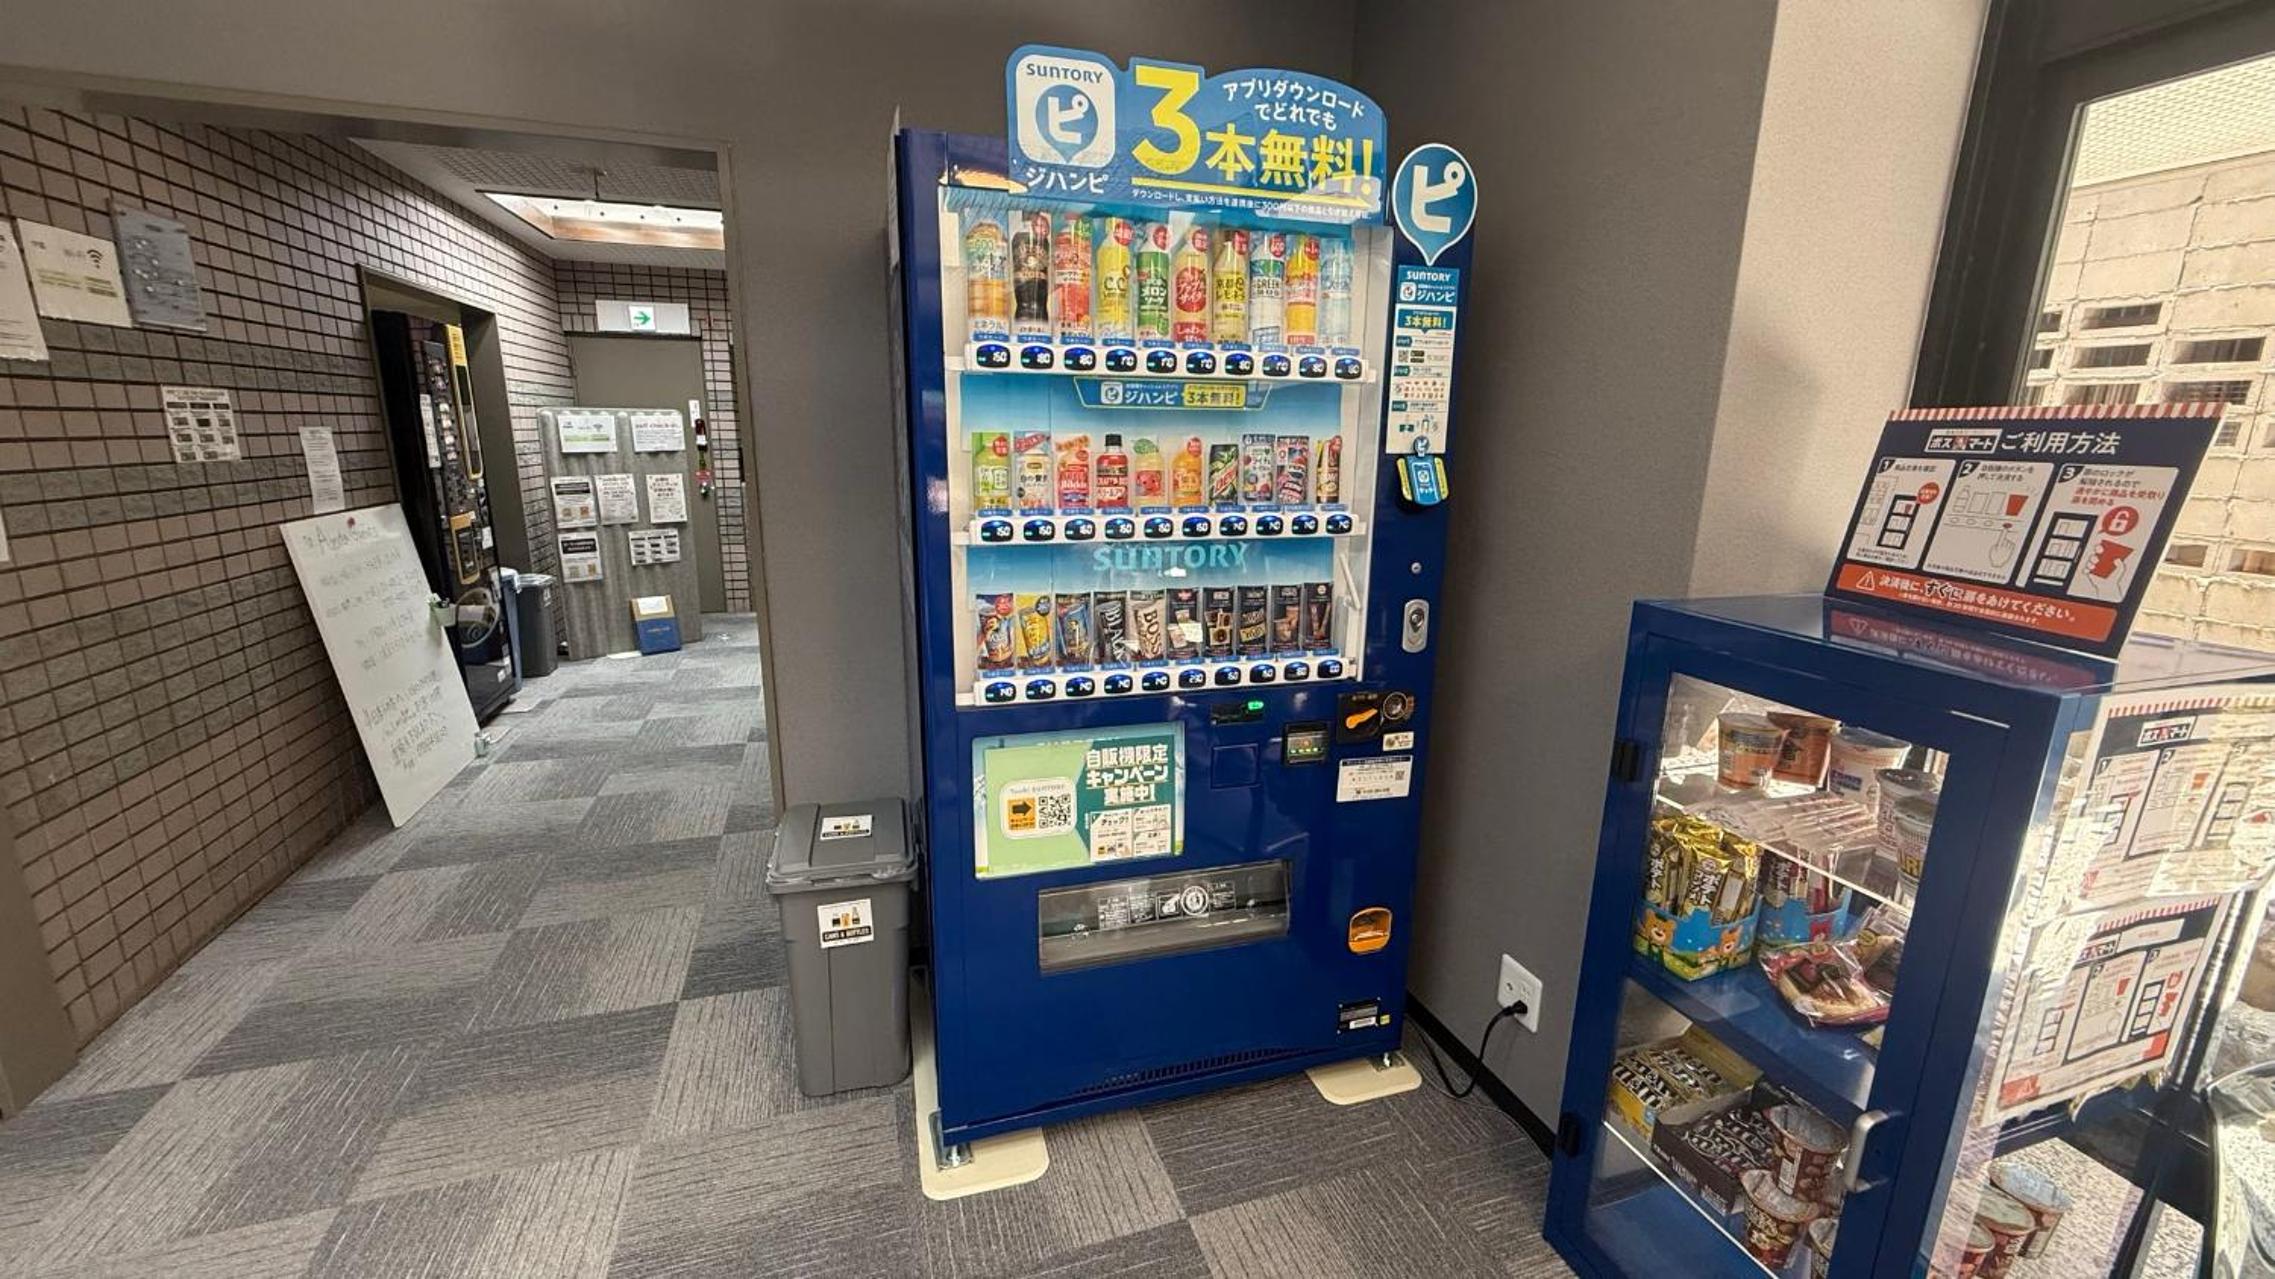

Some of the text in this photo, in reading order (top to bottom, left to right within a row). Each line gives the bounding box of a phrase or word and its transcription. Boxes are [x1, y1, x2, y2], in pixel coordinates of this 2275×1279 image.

[1026, 63, 1104, 83] SUNTORY
[1222, 78, 1366, 119] アプリダウンロード
[1254, 102, 1337, 131] でどれでも
[1025, 167, 1109, 194] ジハンピ
[1410, 160, 1466, 234] ピ
[1406, 270, 1451, 282] SUNTORY
[1416, 289, 1456, 302] ジハンピ
[1404, 315, 1447, 328] 3本無料!
[1124, 390, 1179, 405] ジハンピ
[1186, 391, 1241, 405] 3本無料!
[2001, 431, 2122, 455] ご利用方法
[1963, 464, 1973, 474] 2
[2062, 466, 2076, 480] 3
[1093, 541, 1250, 572] SUNTORY
[1144, 609, 1163, 655] BOSS
[1086, 744, 1169, 768] 自販機限定
[1086, 764, 1169, 788] キャンペーン
[1104, 784, 1156, 806] 実施中!
